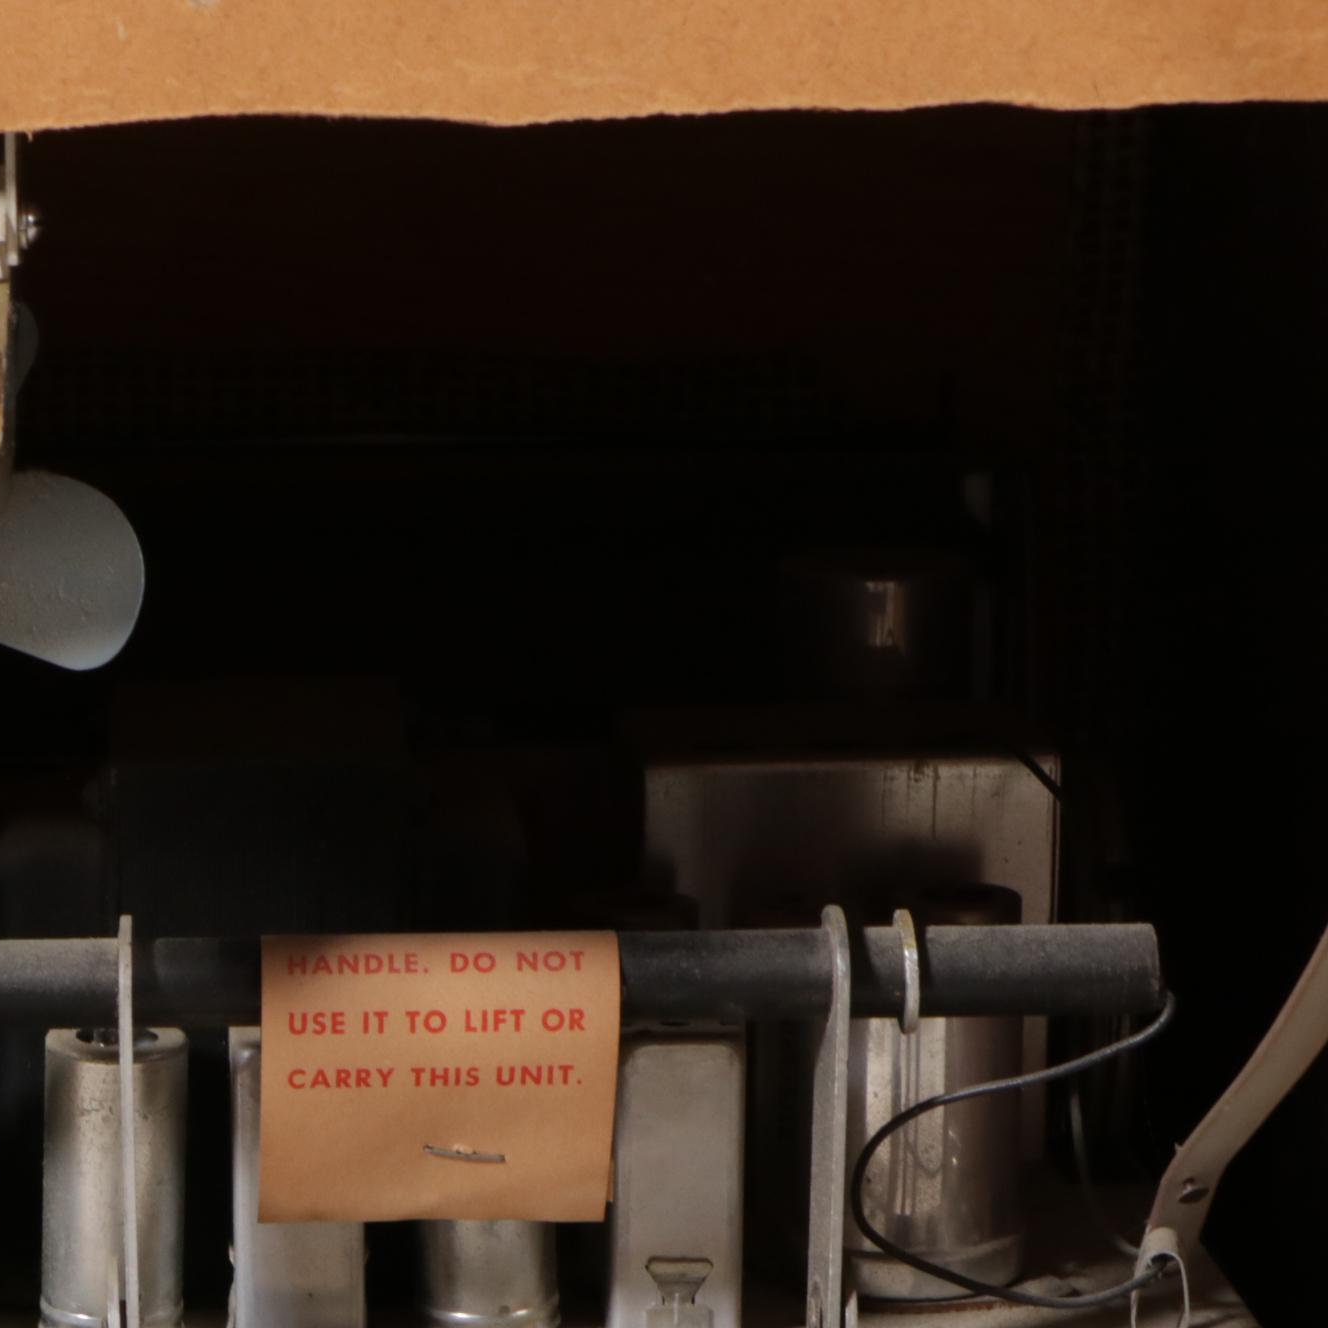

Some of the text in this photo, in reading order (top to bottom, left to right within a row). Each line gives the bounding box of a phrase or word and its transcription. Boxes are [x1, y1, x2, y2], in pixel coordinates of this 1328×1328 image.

[287, 950, 585, 975] HANDLE. DO NOT
[288, 1007, 585, 1036] USE IT TO LIFT OR
[287, 1064, 582, 1090] CARRY THIS UNIT.
